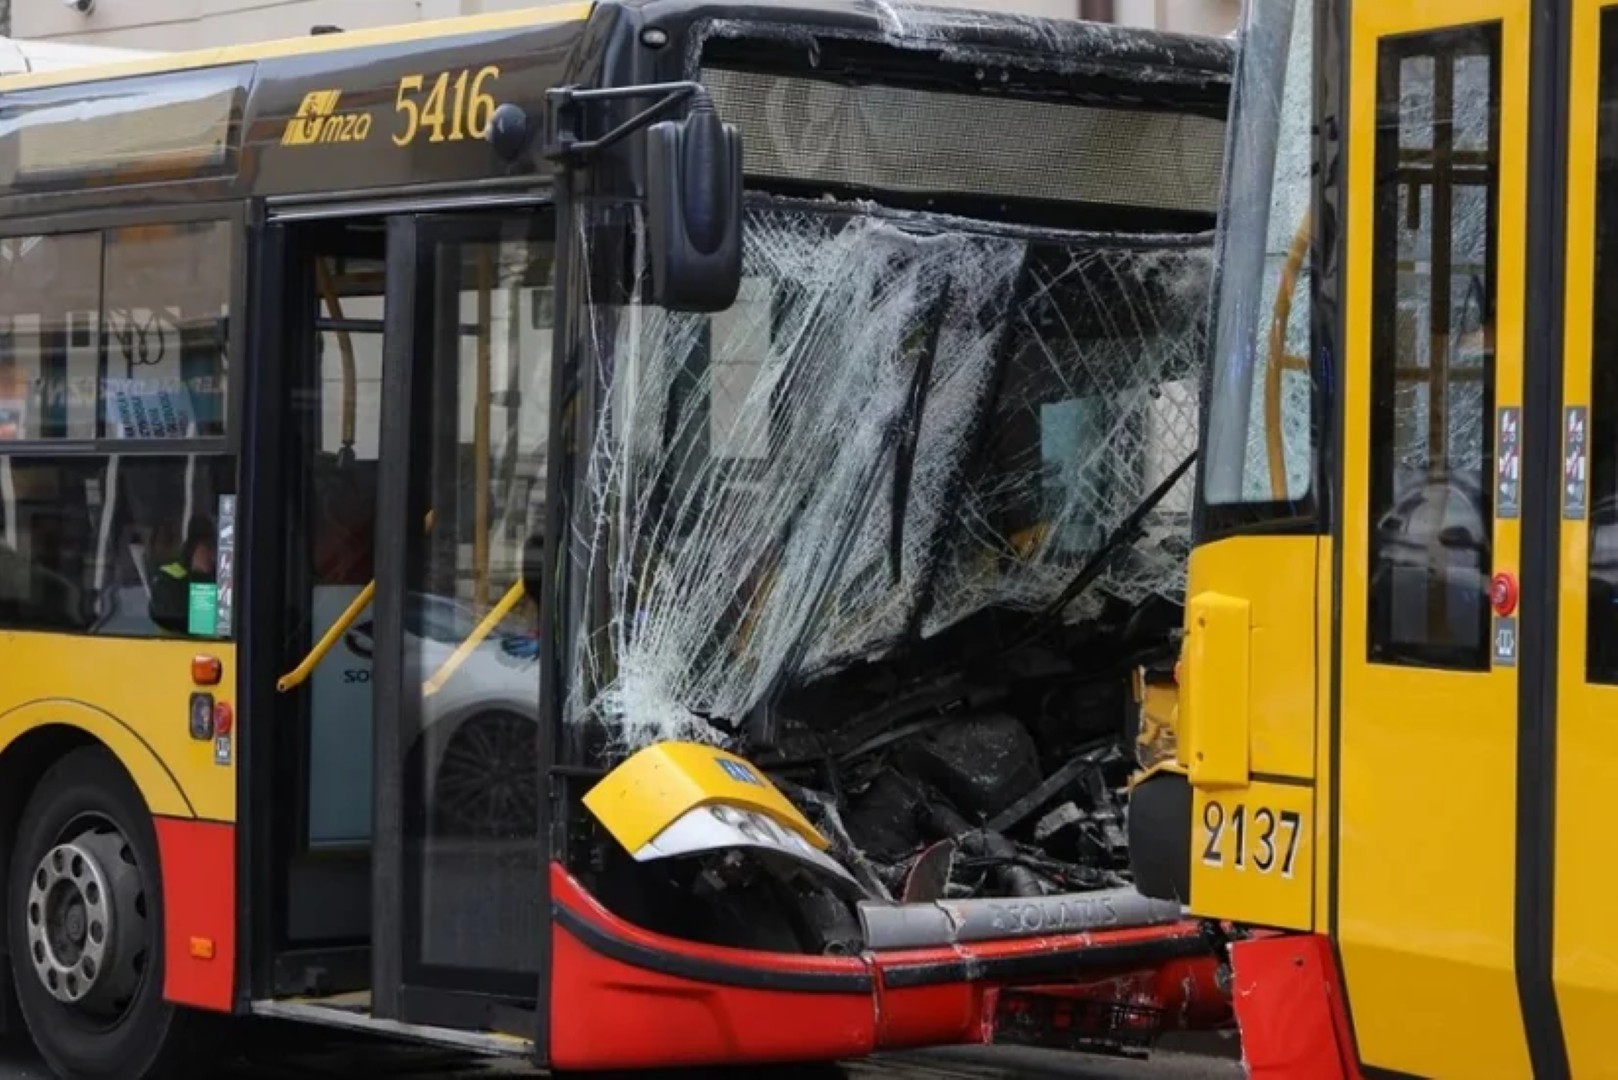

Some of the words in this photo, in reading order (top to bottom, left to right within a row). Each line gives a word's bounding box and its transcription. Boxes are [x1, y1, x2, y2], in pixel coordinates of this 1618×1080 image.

[321, 112, 372, 143] mza
[391, 65, 499, 146] 5416
[1203, 800, 1302, 879] 2137
